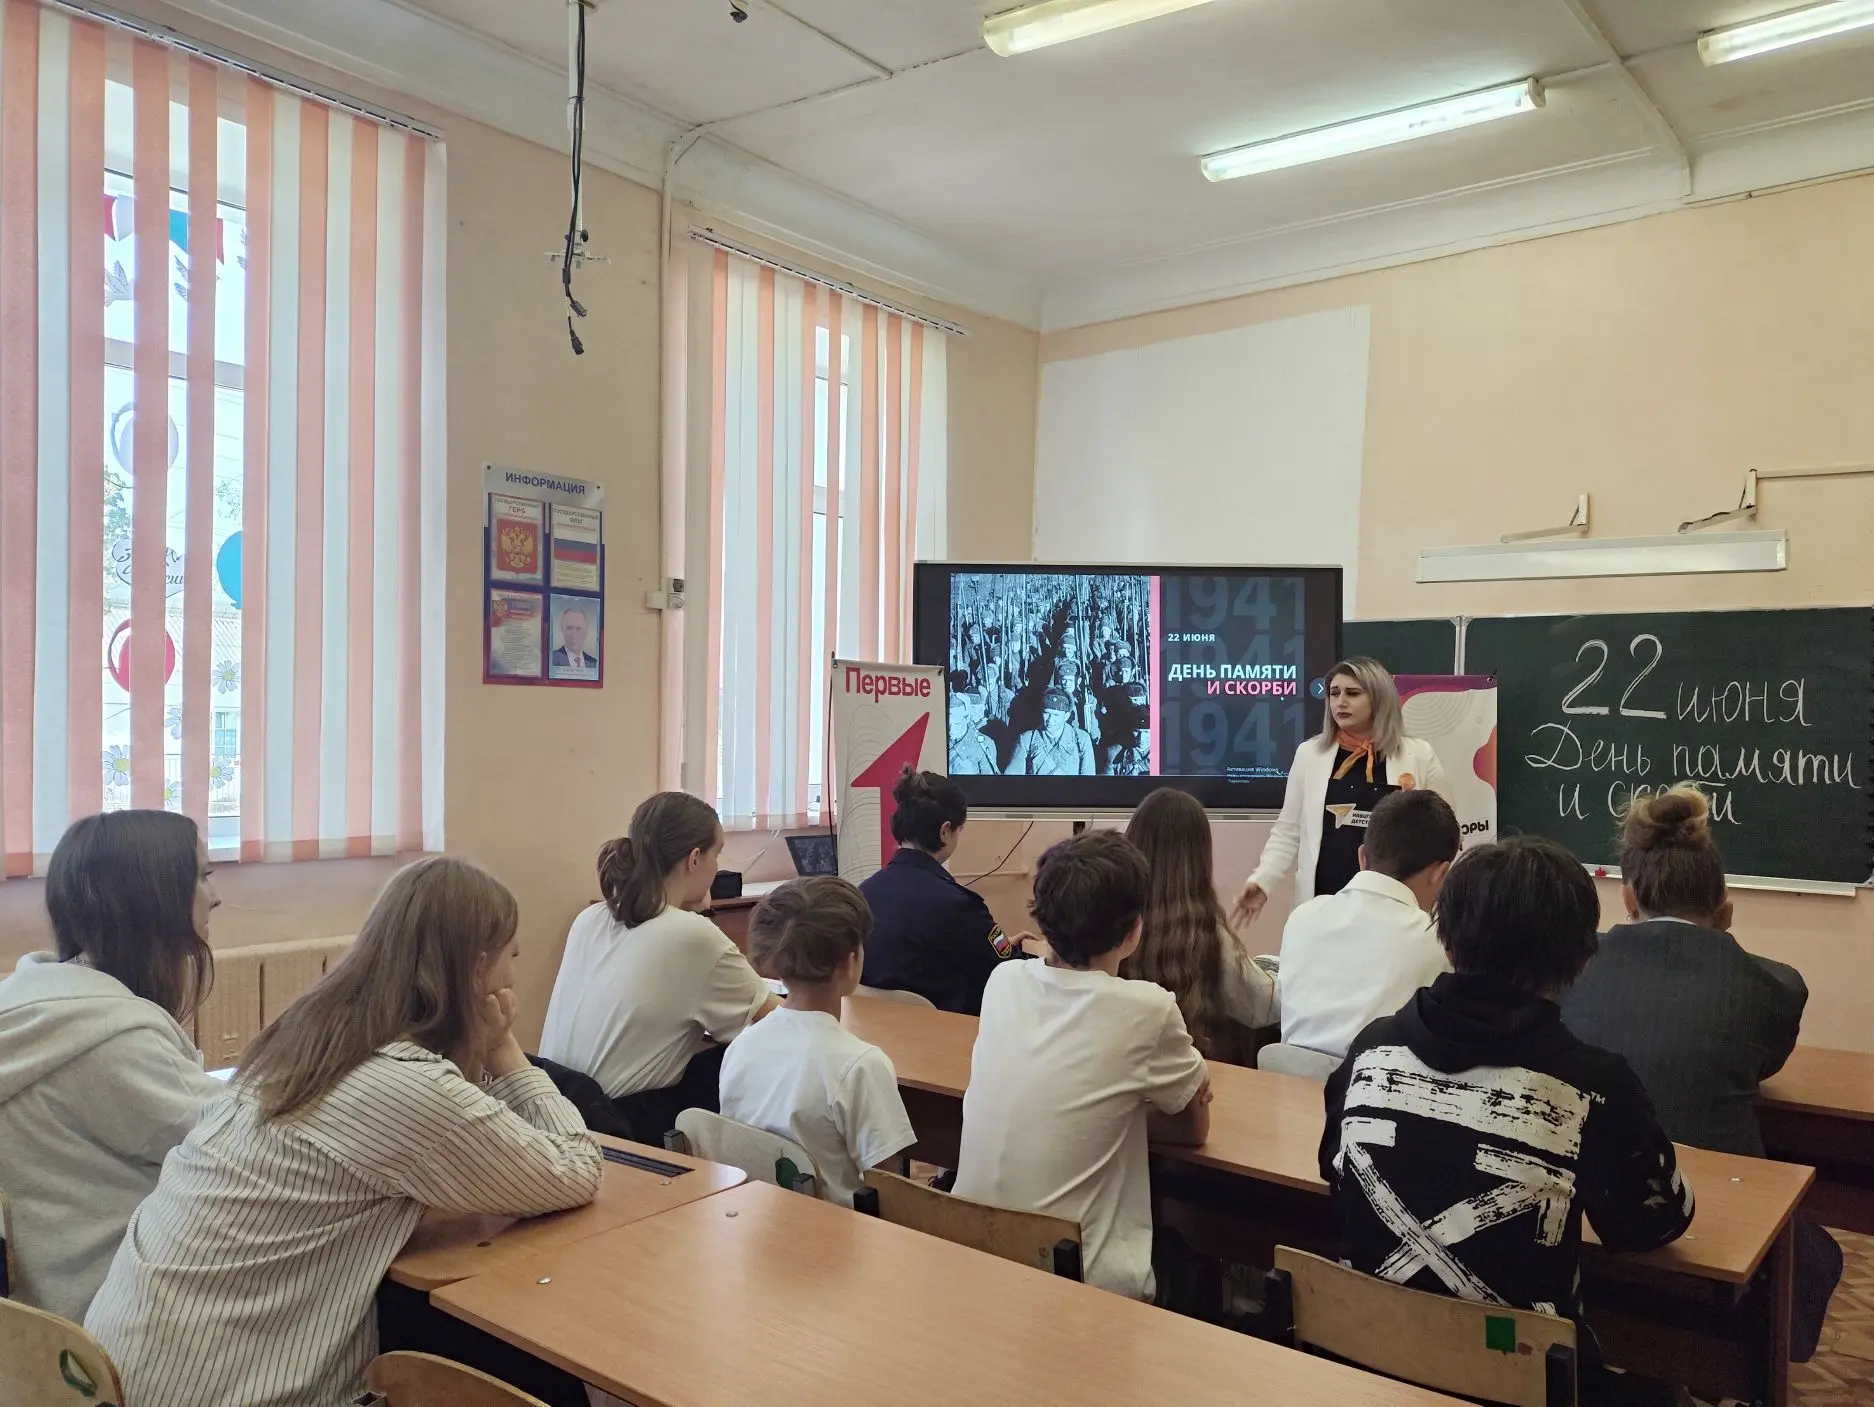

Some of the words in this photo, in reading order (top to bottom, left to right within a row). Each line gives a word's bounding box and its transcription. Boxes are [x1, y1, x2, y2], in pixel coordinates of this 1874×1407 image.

[505, 471, 585, 495] ИНФОРМАЦИЯ
[1167, 633, 1180, 642] 22
[1183, 633, 1216, 642] ИЮНЯ
[845, 666, 931, 703] Первые
[1168, 663, 1217, 681] ДЕНЬ
[1220, 664, 1297, 679] ПАМЯТИ
[1561, 633, 1667, 719] 22
[1677, 678, 1813, 727] июня
[1207, 680, 1220, 695] И
[1224, 681, 1297, 695] СКОРБИ
[1524, 720, 1652, 776] День
[1673, 741, 1862, 789] памяти
[1559, 783, 1590, 820] и
